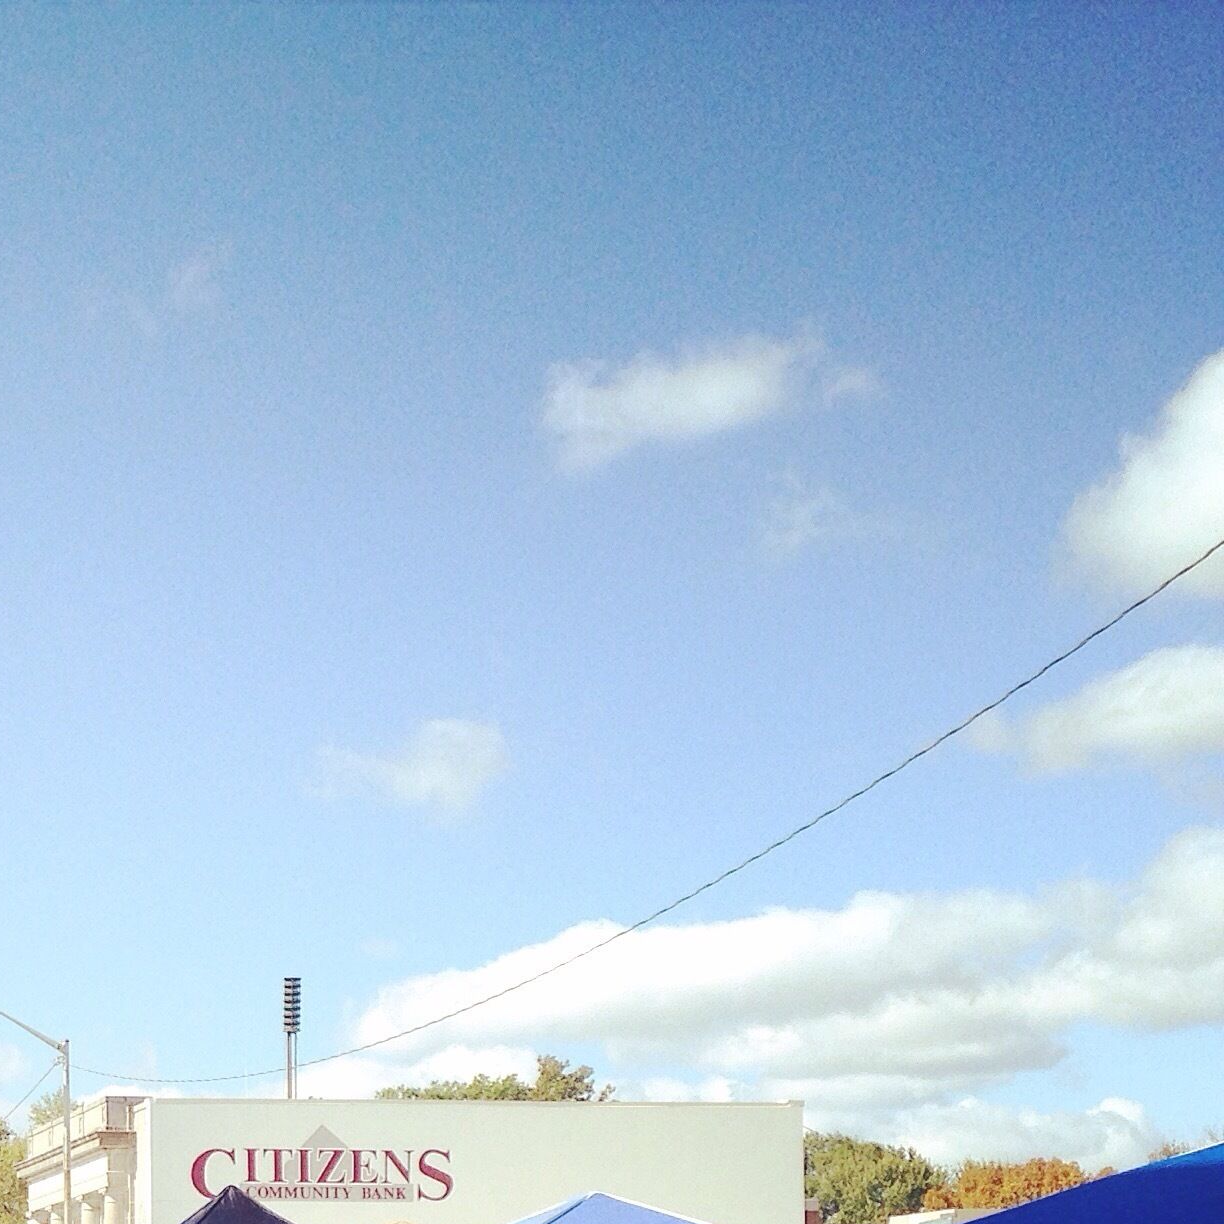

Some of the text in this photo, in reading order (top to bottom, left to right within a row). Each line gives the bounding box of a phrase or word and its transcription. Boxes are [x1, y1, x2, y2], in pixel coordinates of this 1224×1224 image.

[190, 1148, 453, 1201] CITIZENS
[246, 1185, 407, 1200] COMMUNITY BANK
